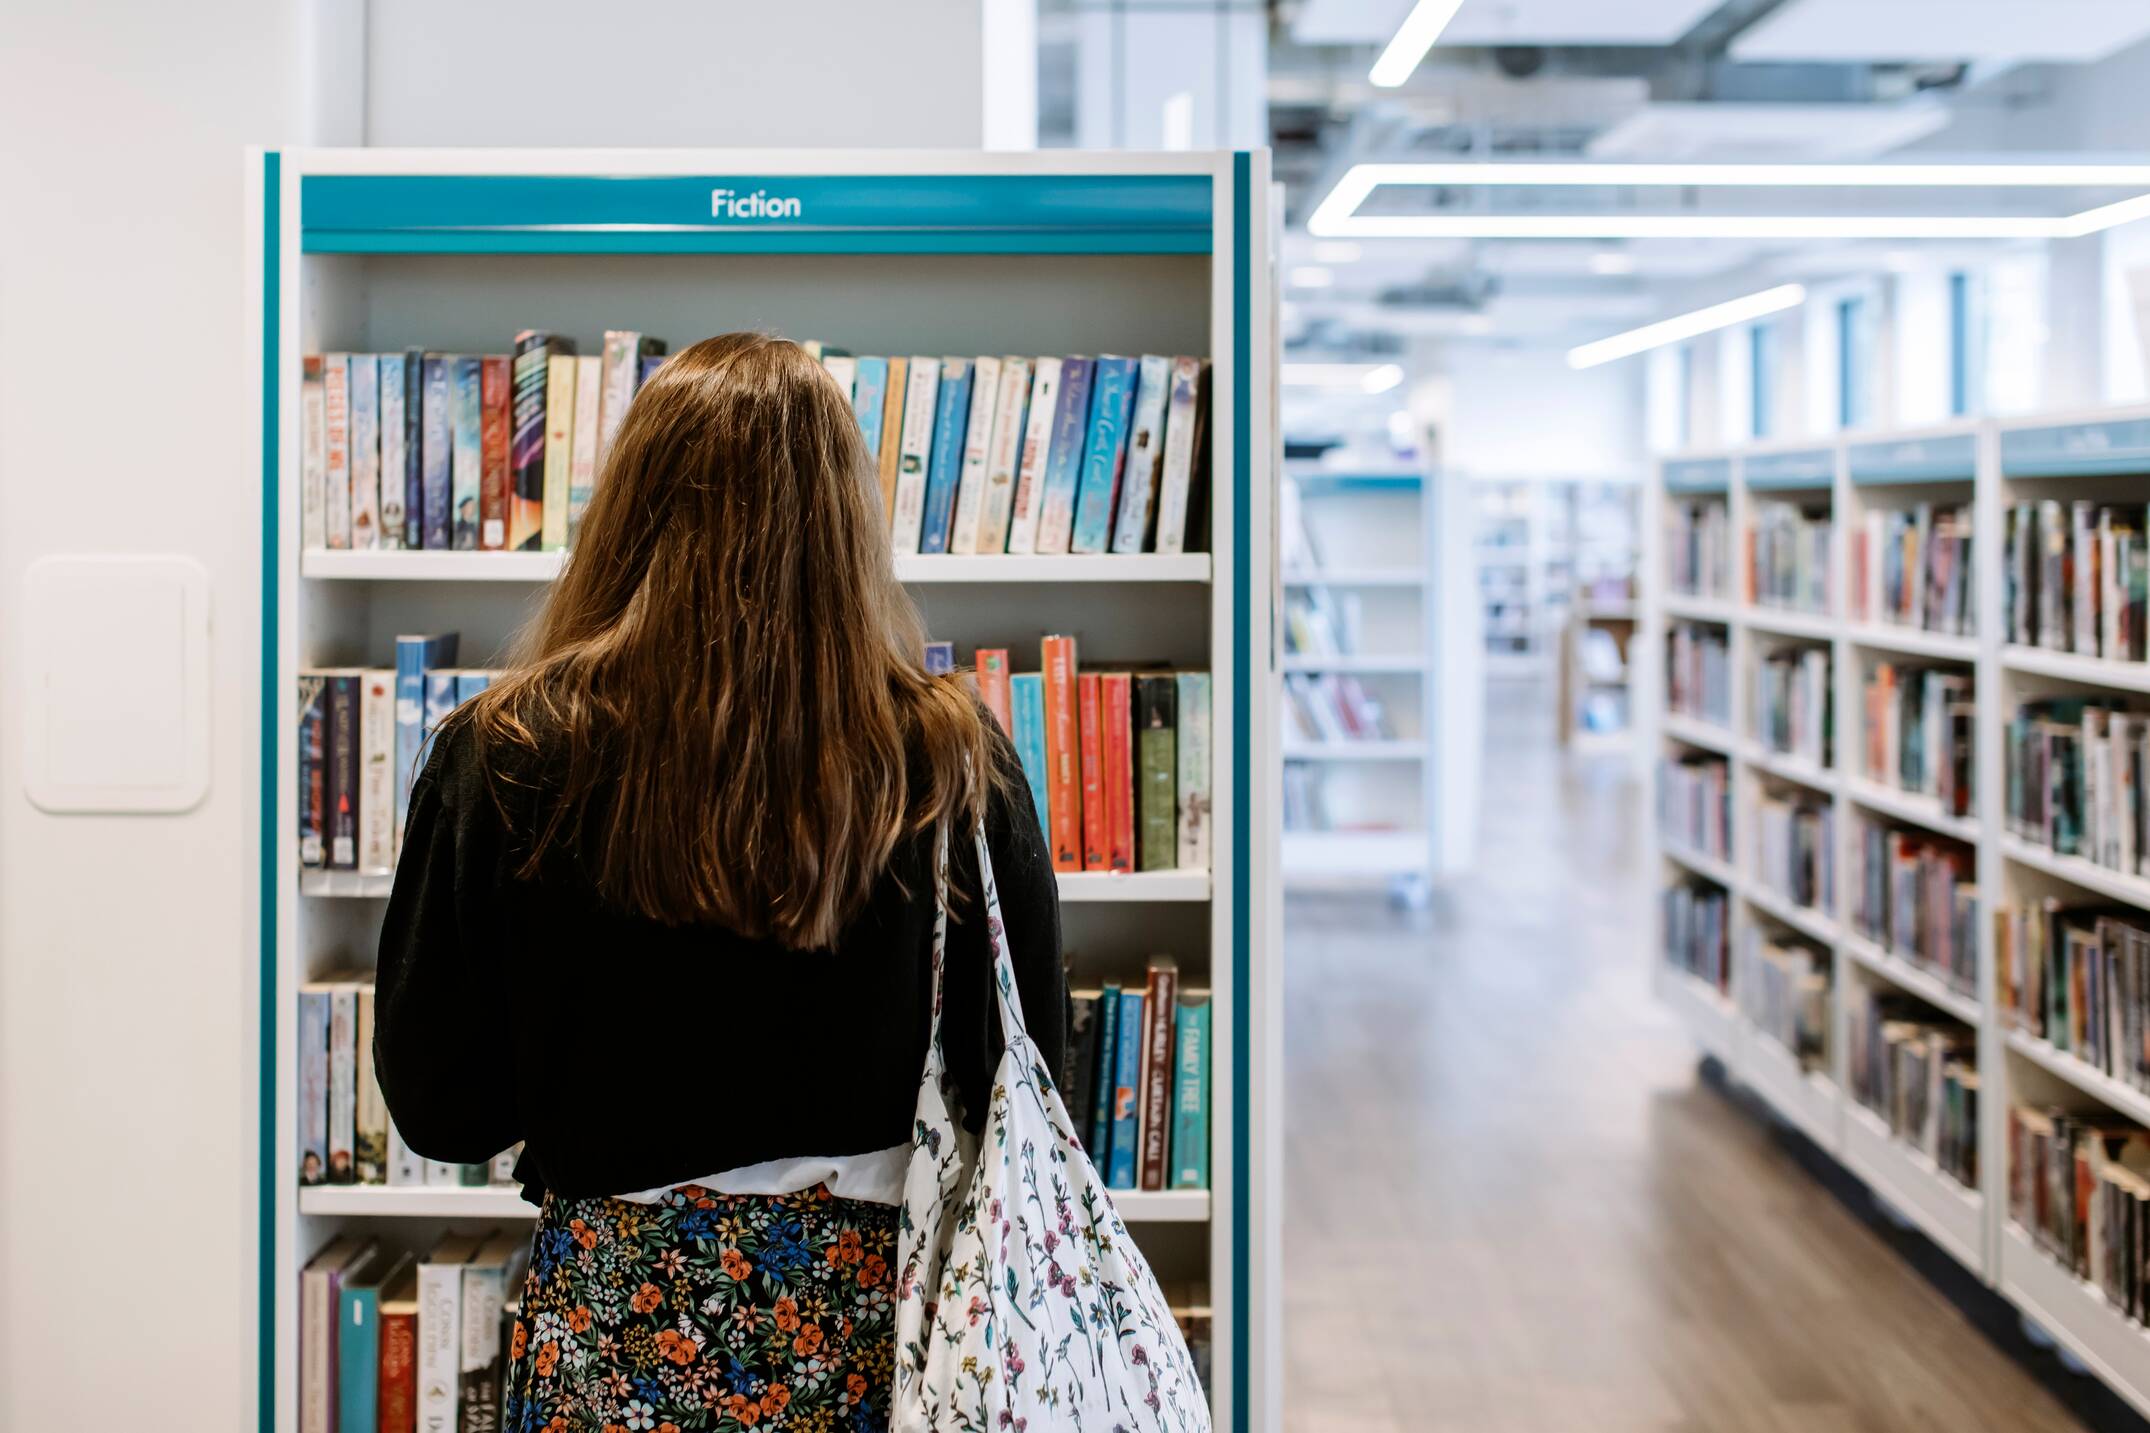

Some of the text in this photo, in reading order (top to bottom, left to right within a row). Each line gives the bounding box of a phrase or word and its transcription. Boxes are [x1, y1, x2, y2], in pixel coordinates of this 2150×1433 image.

[711, 188, 801, 218] Fiction
[1154, 1017, 1168, 1063] HURLEY
[1182, 1027, 1201, 1077] FAMILY
[1150, 1070, 1166, 1127] CURTAIN
[1180, 1079, 1201, 1113] TREE
[1148, 1130, 1162, 1161] CALL
